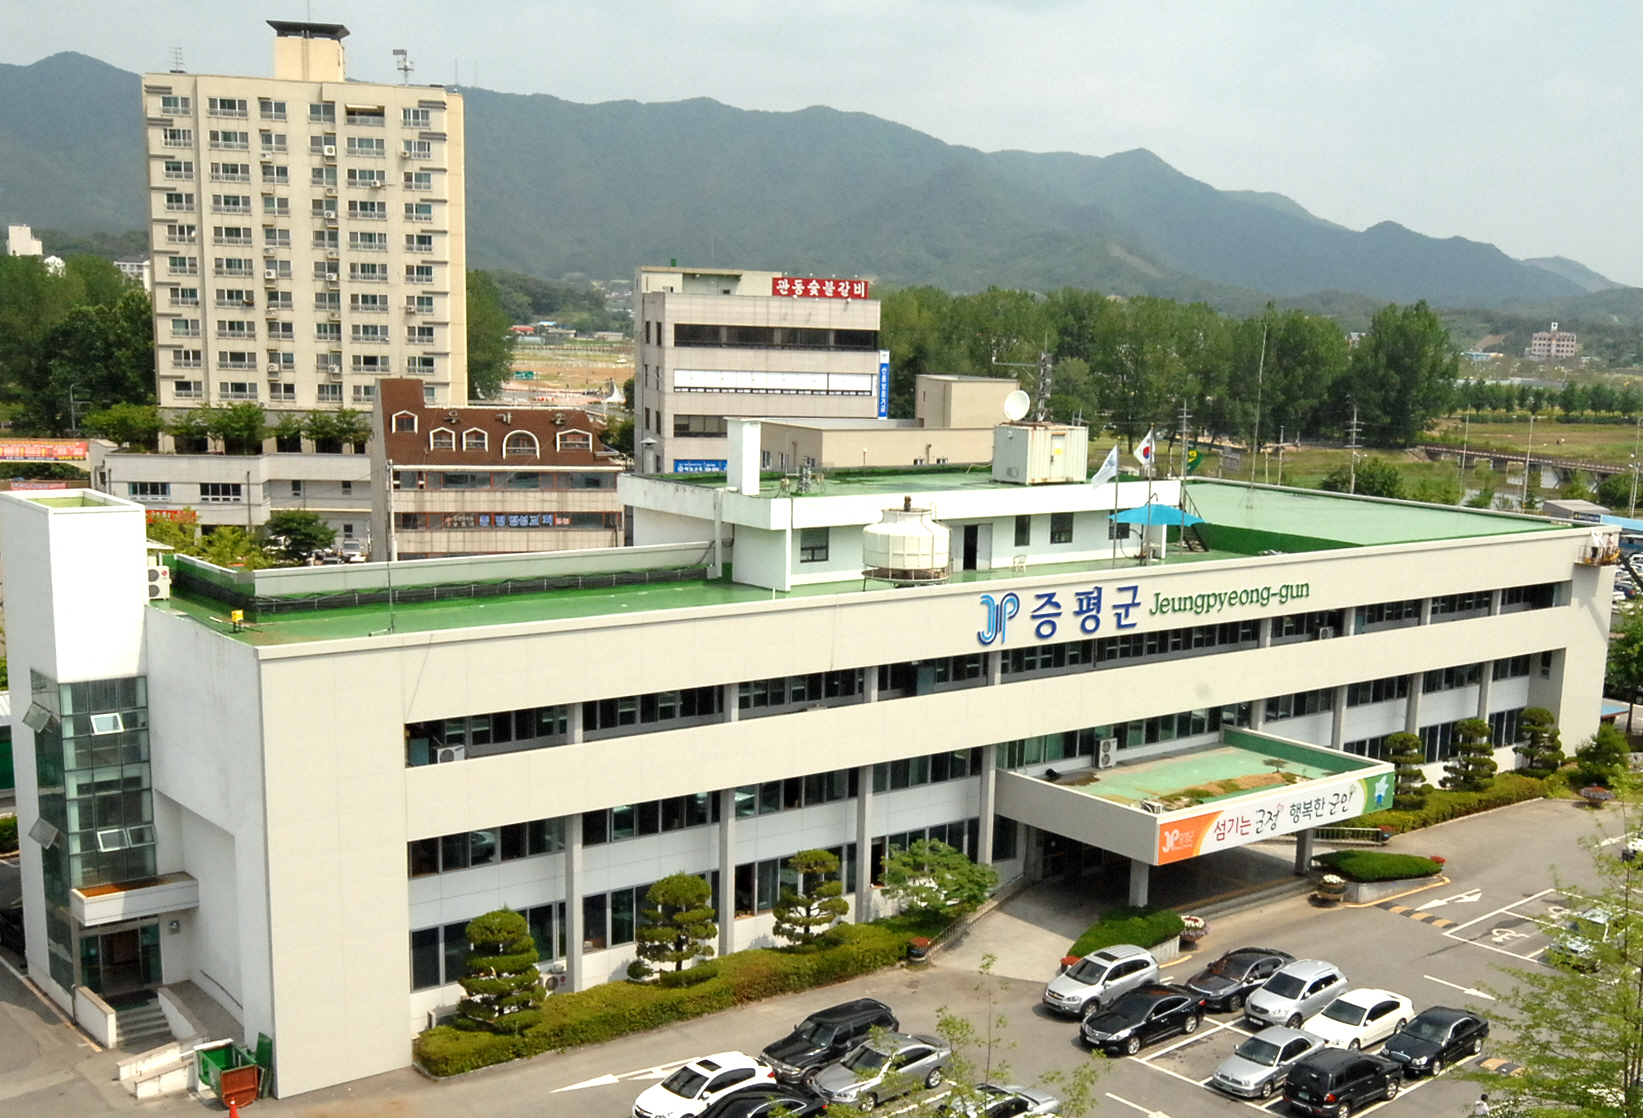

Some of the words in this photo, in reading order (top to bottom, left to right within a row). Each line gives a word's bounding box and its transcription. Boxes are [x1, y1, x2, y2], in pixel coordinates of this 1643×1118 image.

[776, 278, 865, 298] 관동숯불갈비
[1031, 585, 1141, 640] 증평군
[1150, 581, 1310, 616] Jeungpyeong-gun
[1213, 815, 1252, 841] 섬기는
[1255, 808, 1281, 835] 군정
[1289, 797, 1326, 824] 행복한
